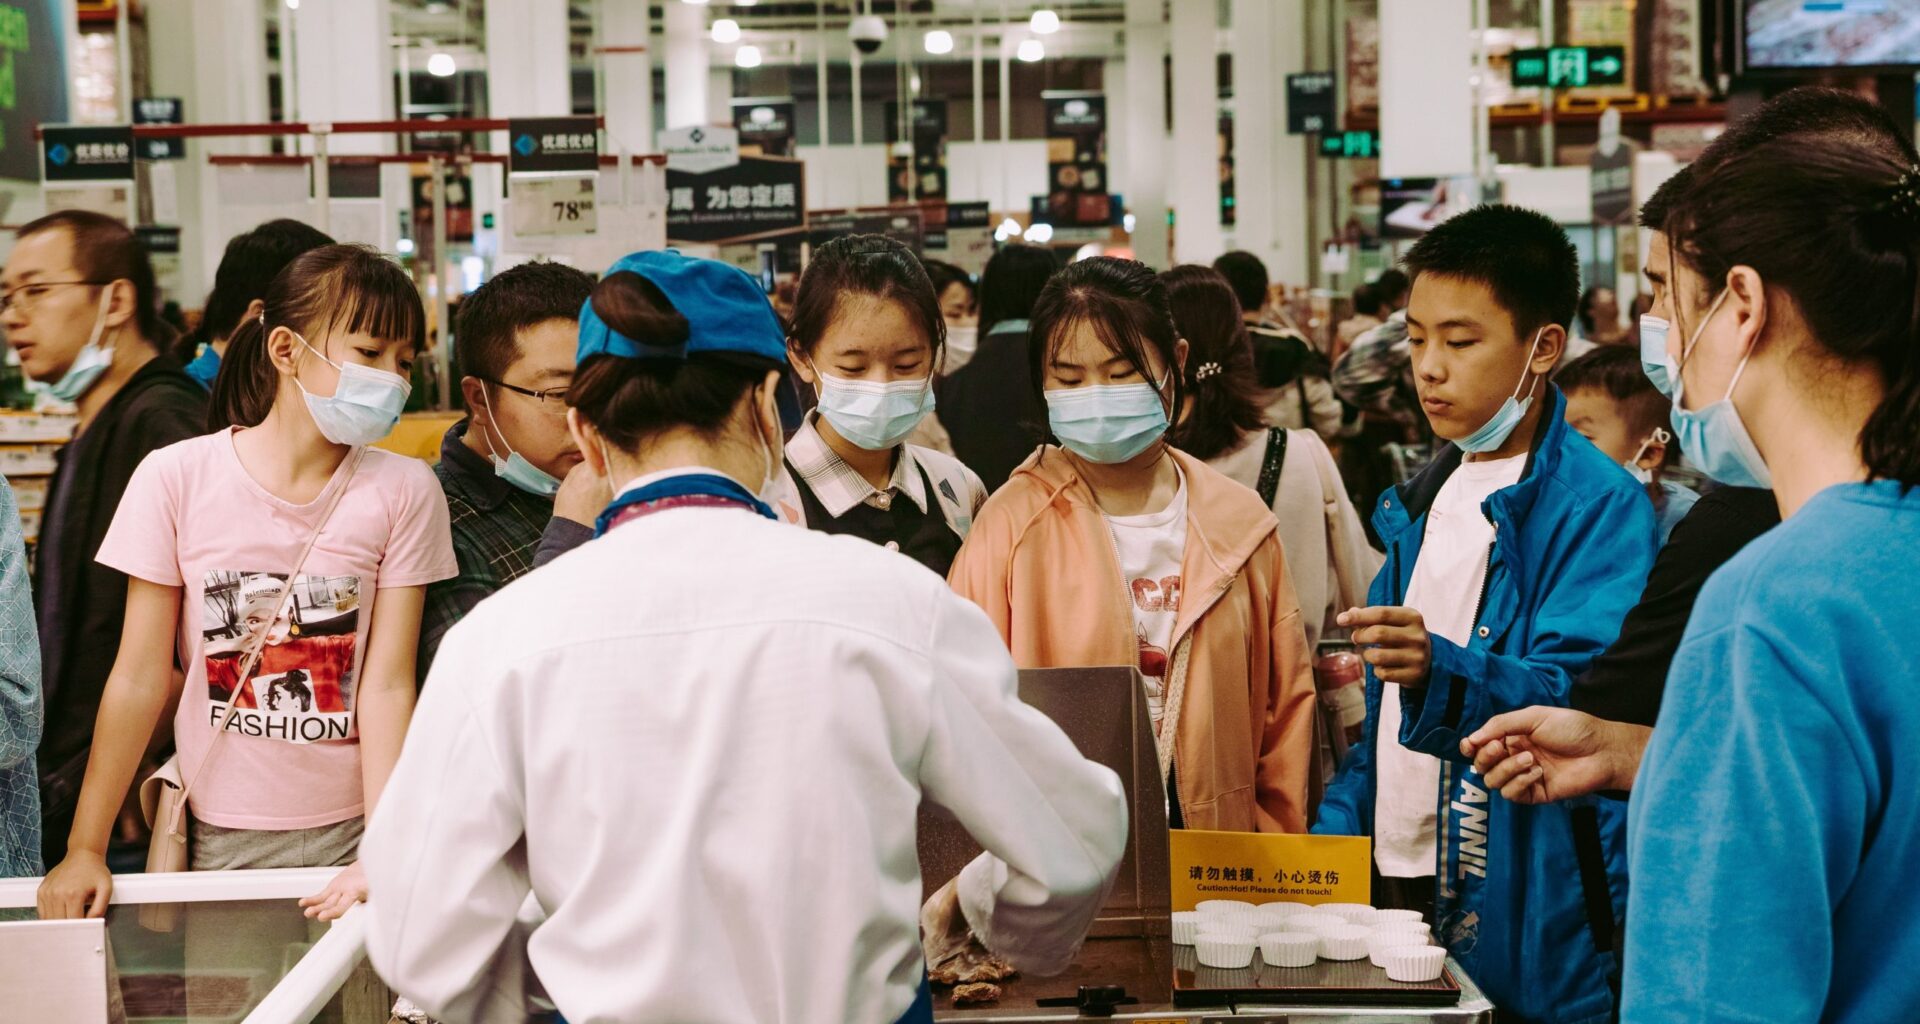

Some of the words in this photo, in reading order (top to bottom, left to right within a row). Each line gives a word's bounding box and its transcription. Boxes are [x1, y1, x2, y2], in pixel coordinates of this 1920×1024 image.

[541, 133, 595, 150] 优质优价
[706, 183, 796, 210] 为您定质
[553, 201, 580, 222] 78
[210, 705, 349, 741] FASHION
[1250, 886, 1277, 894] Please
[1278, 886, 1289, 894] do
[1306, 888, 1332, 896] touch!
